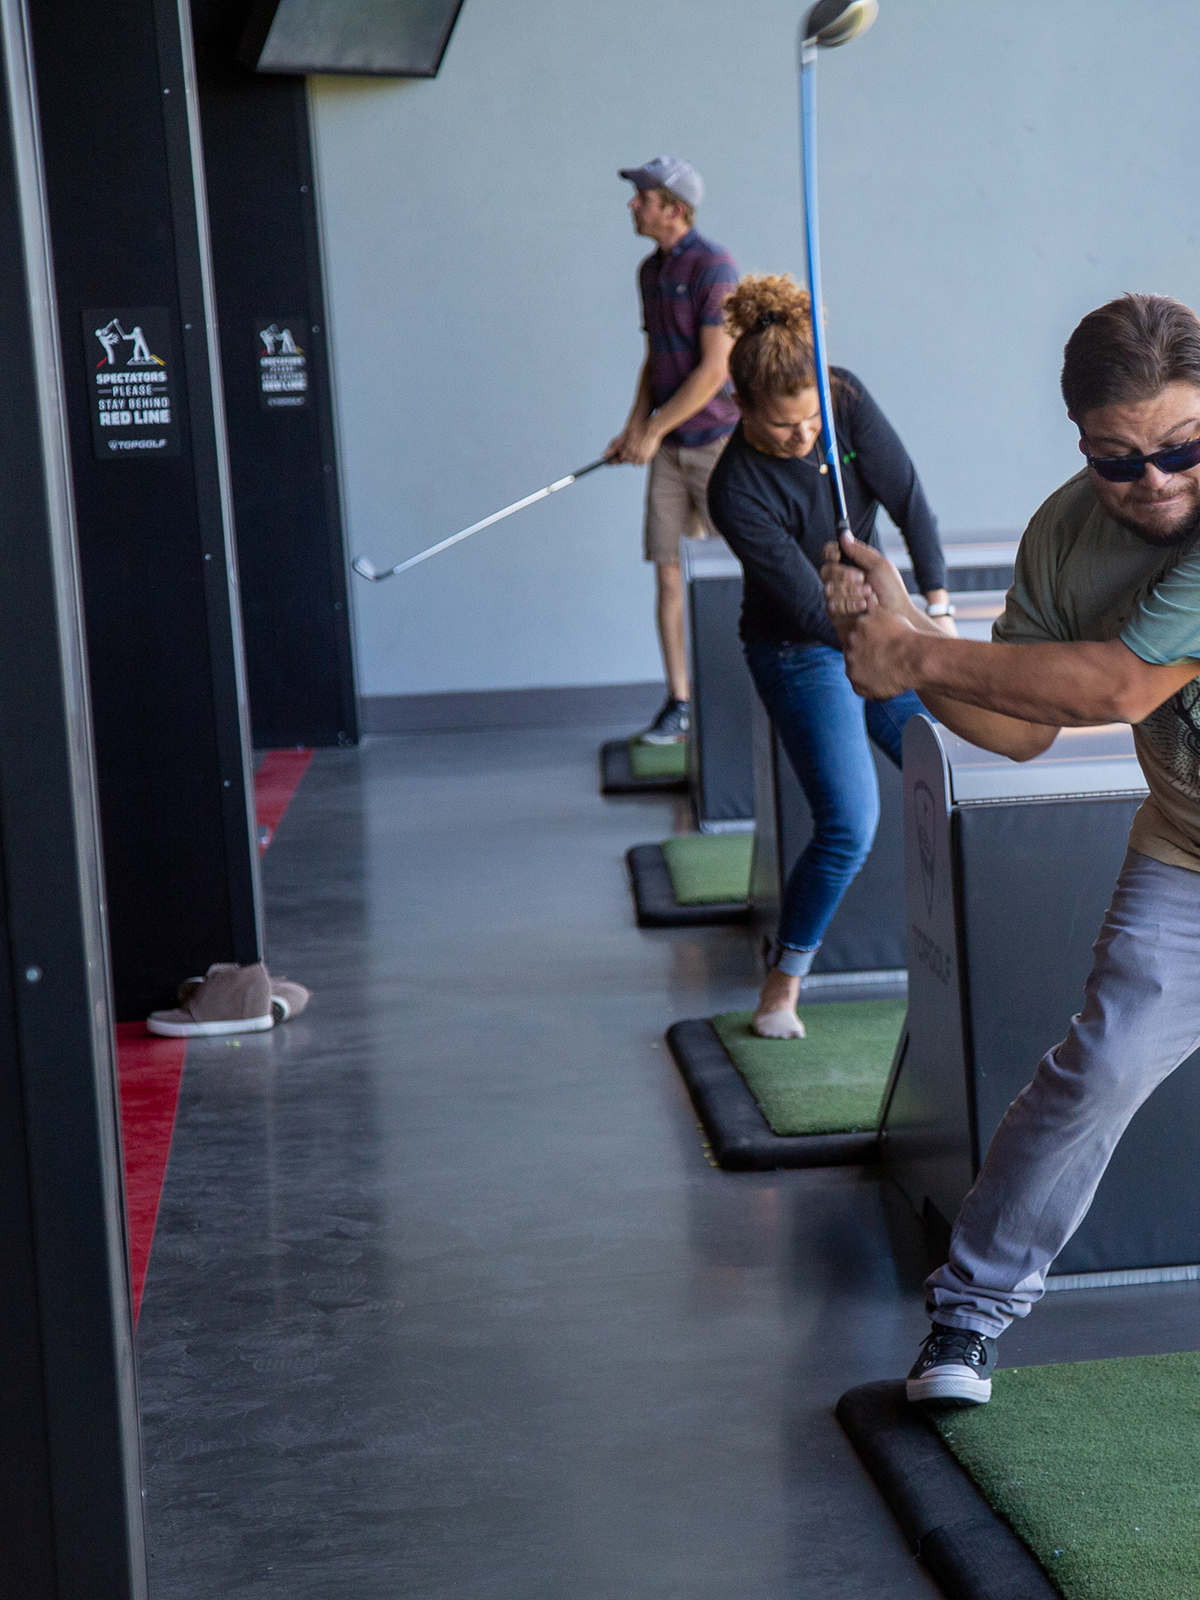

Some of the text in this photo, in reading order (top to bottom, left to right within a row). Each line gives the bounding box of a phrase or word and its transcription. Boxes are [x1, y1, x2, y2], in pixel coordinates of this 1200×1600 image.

[96, 371, 167, 384] SPECTATORS
[112, 384, 153, 397] PLEASE
[98, 396, 170, 411] STAY BEHIND
[100, 409, 171, 426] RED LINE
[117, 438, 167, 450] TOPGOLF
